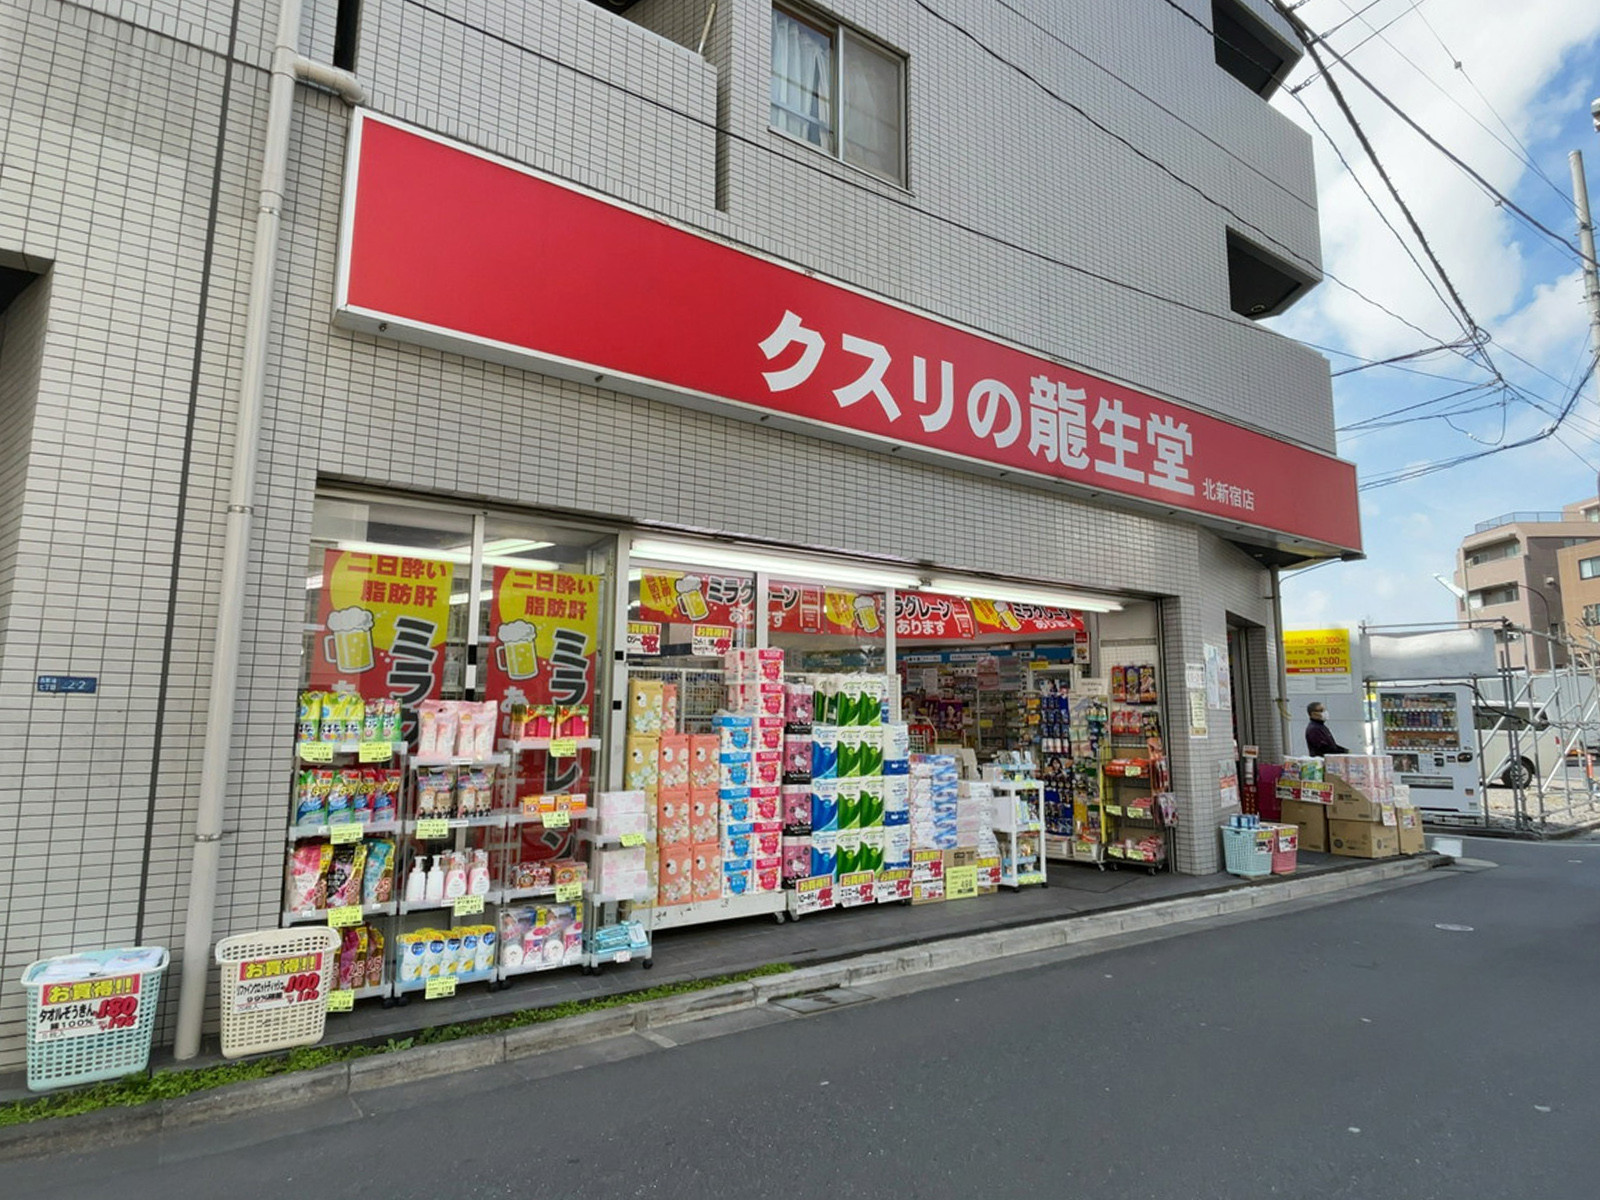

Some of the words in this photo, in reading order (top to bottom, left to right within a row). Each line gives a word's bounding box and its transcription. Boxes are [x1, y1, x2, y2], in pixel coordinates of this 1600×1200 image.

[757, 309, 1196, 497] クスリの龍生堂
[1202, 477, 1256, 512] 北新宿店
[347, 553, 447, 580] 二日酔い
[360, 580, 438, 608] 脂肪肝
[513, 571, 594, 596] 二日酔い
[706, 575, 799, 612] ミラグーン
[523, 596, 588, 622] 脂肪肝
[896, 619, 947, 636] あります
[246, 956, 316, 979] お買得!!
[48, 977, 132, 1003] お買得!!
[285, 972, 320, 993] 100
[39, 1003, 94, 1023] タオルぞうきん
[97, 996, 138, 1019] 180
